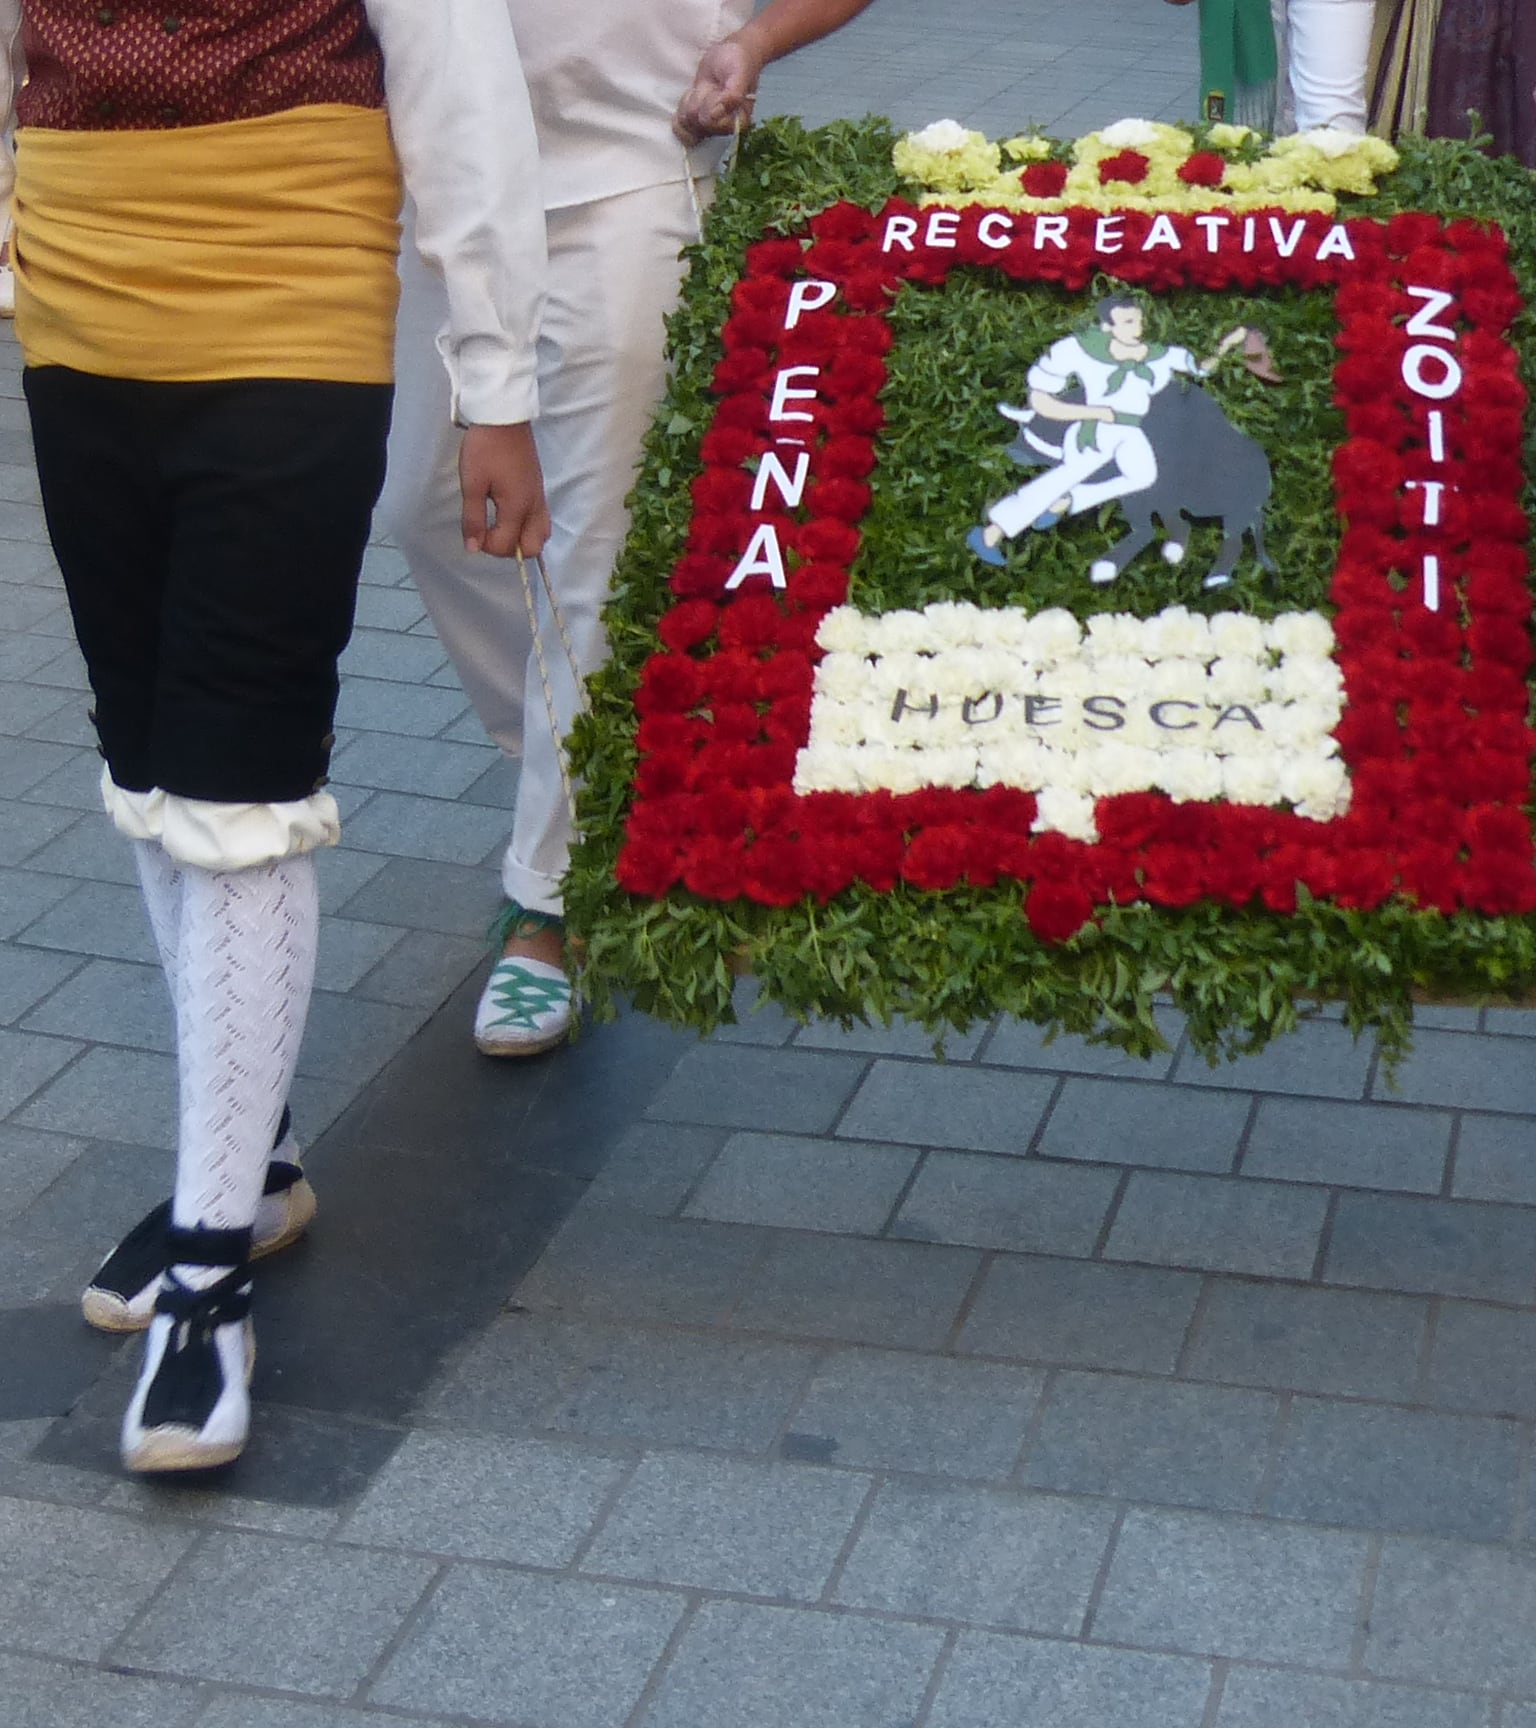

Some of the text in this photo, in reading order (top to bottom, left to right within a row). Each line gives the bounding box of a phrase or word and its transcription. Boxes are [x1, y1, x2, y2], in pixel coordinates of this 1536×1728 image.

[882, 212, 1356, 261] RECREATIVA
[724, 280, 837, 590] PEÑA
[1401, 285, 1462, 613] ZOITI
[890, 688, 1265, 731] HUESCA
